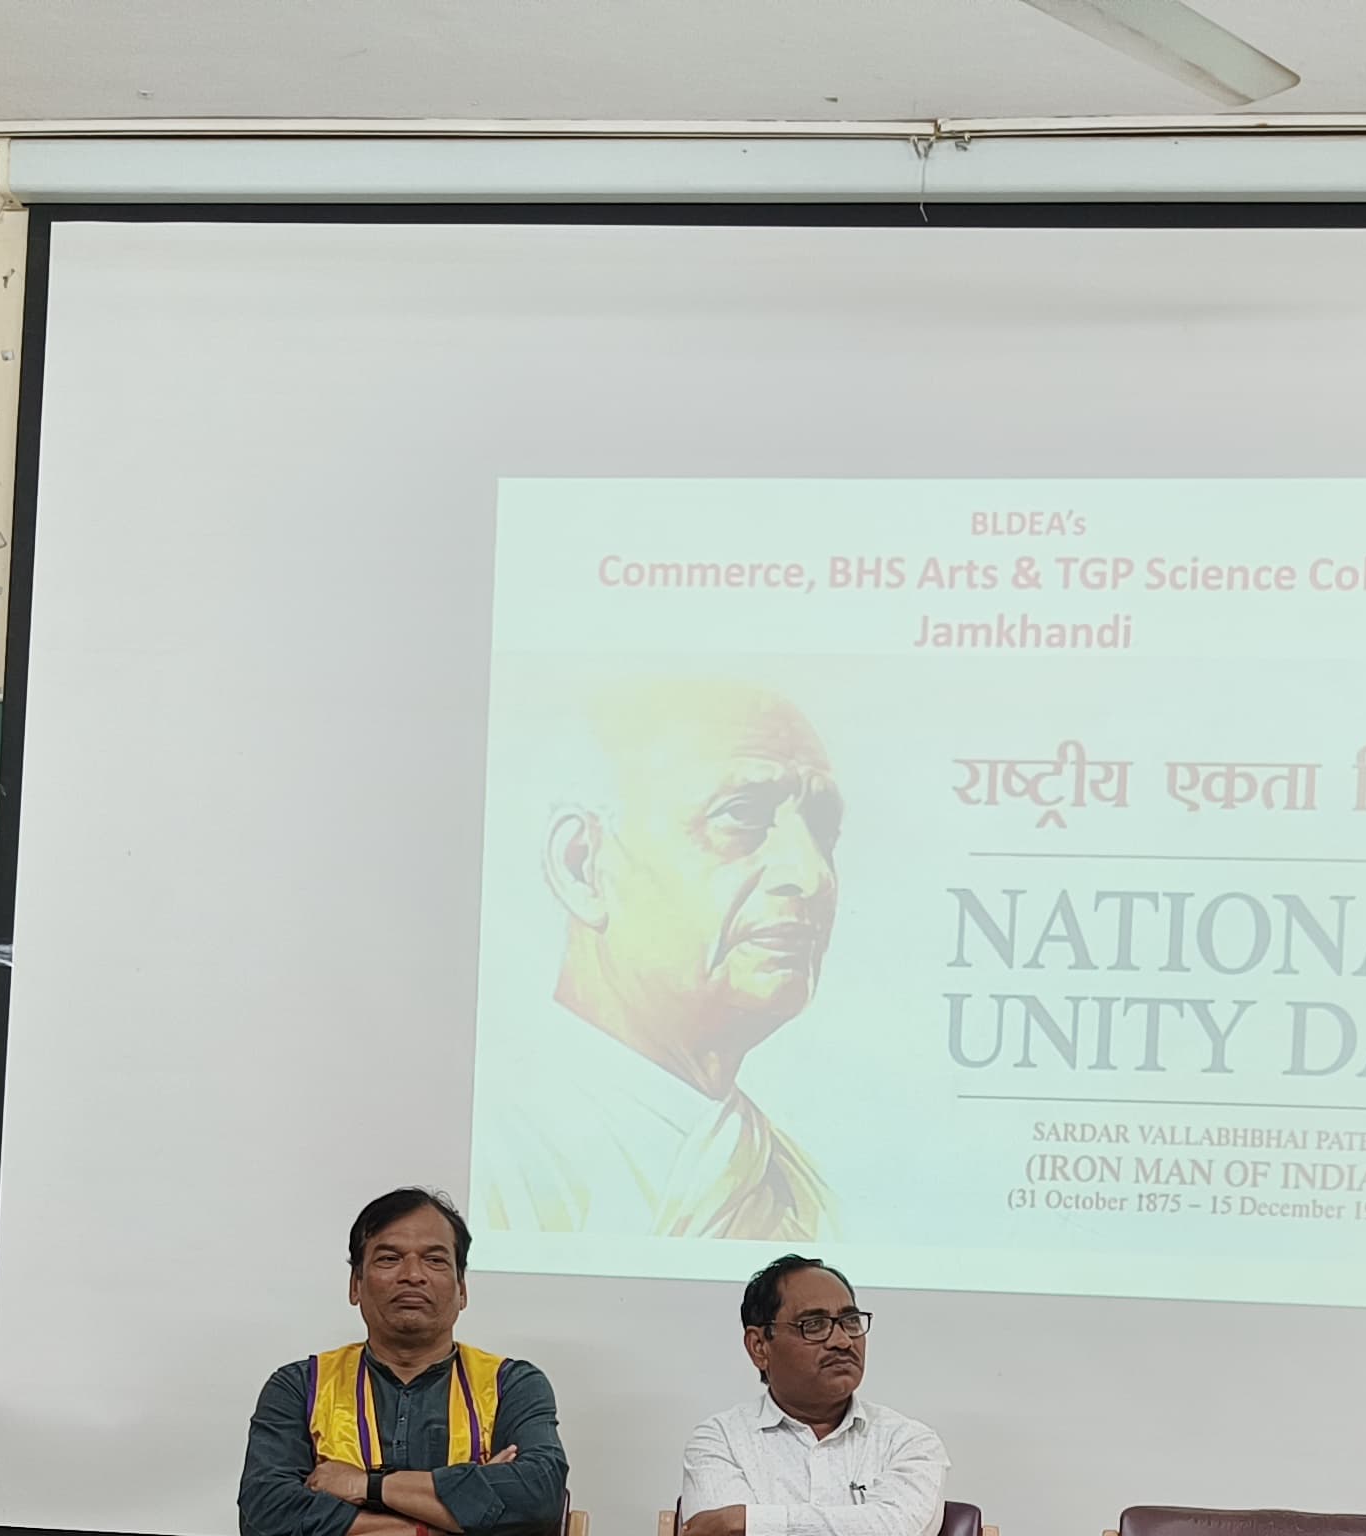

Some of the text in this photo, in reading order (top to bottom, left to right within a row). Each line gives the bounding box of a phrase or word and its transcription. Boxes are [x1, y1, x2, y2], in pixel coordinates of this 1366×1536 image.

[972, 509, 1087, 538] BLDEA's
[599, 554, 816, 594] Commerce,
[828, 557, 906, 590] BHS
[917, 556, 998, 590] Arts
[1011, 557, 1042, 590] &
[1055, 557, 1134, 591] TGP
[1145, 556, 1296, 592] Science
[914, 614, 1134, 651] Jamkhandi
[953, 739, 1134, 829] राष्ट्रीय
[1165, 762, 1322, 811] एकता
[943, 993, 1257, 1074] UNITY
[1033, 1121, 1130, 1144] SARDAR
[1138, 1125, 1308, 1150] VALLABHBHAI
[1025, 1153, 1123, 1185] (IRON
[1133, 1157, 1214, 1186] MAN
[1224, 1159, 1270, 1189] OF
[1007, 1188, 1037, 1211] (31
[1045, 1189, 1128, 1212] October
[1136, 1192, 1182, 1213] 1875
[1209, 1195, 1233, 1215] 15
[1239, 1196, 1346, 1220] December
